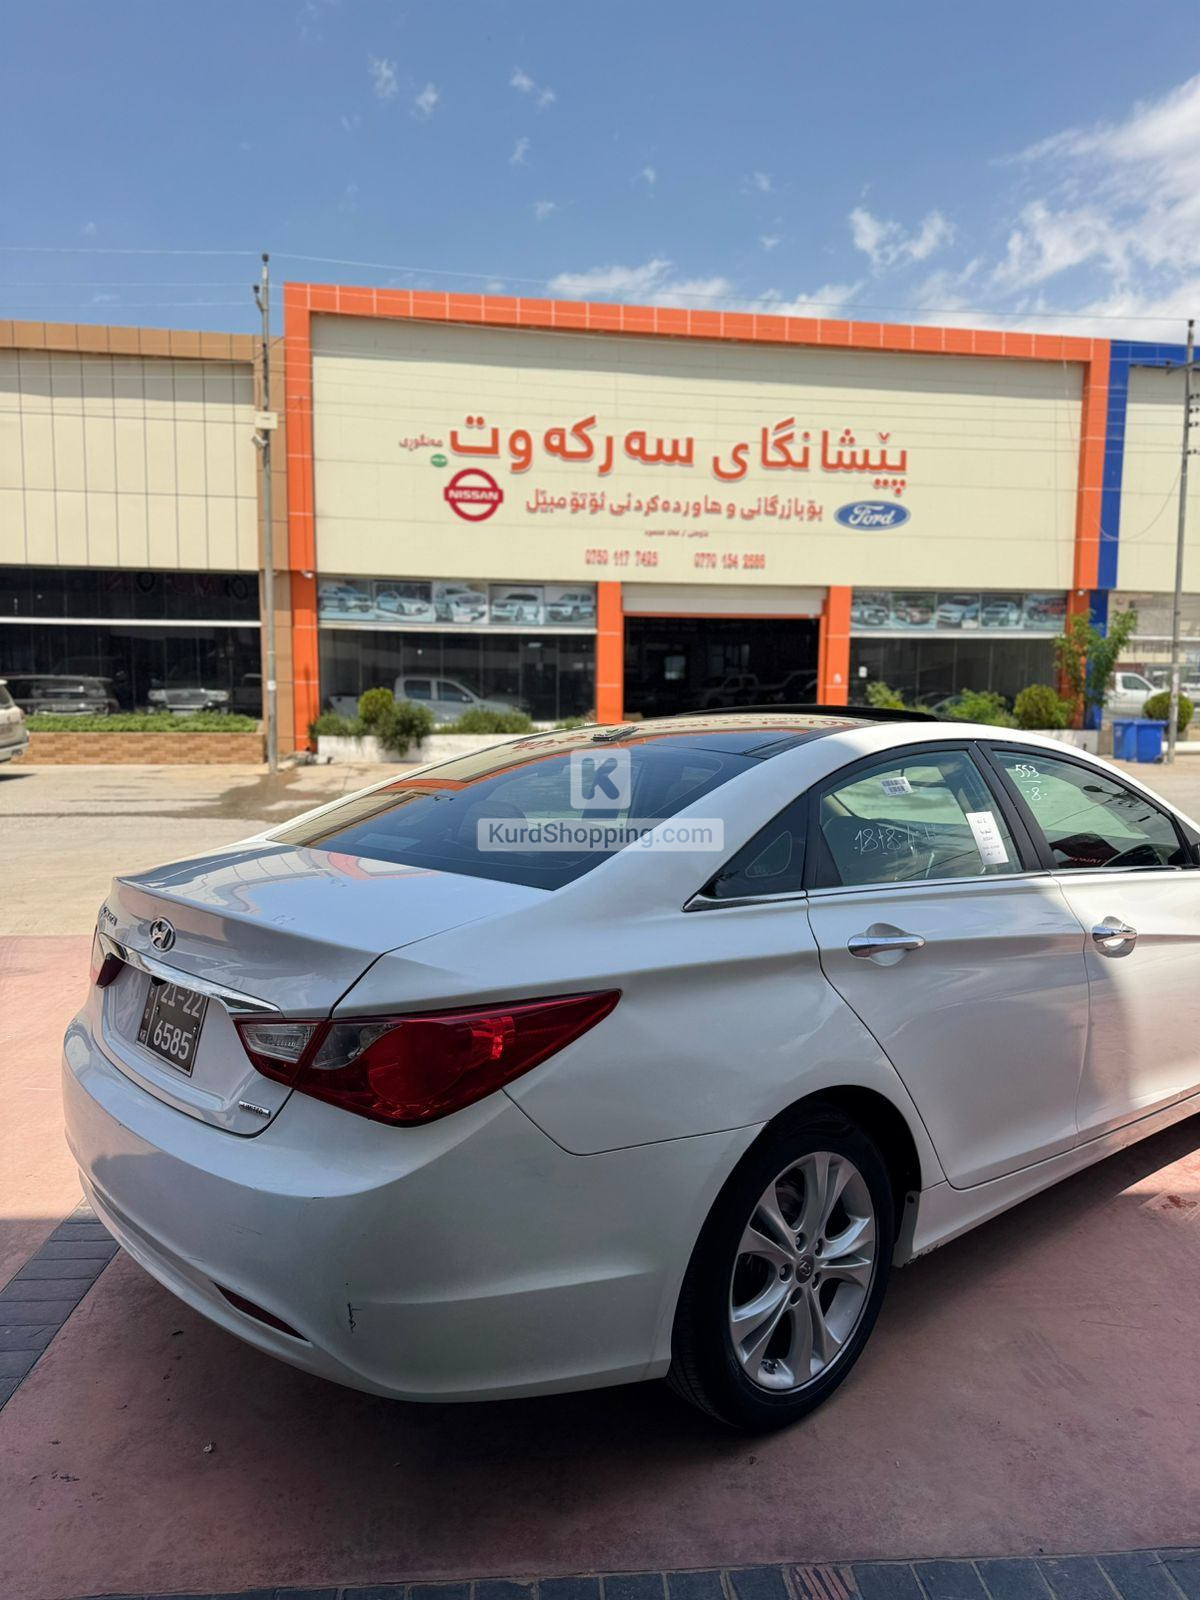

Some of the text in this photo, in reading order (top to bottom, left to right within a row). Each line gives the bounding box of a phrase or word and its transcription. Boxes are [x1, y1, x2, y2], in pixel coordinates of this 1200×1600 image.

[449, 414, 694, 476] سەرکەوت
[448, 488, 500, 501] NISSAN
[848, 503, 896, 526] Ford
[1014, 763, 1040, 778] 553
[153, 1020, 193, 1060] 6585
